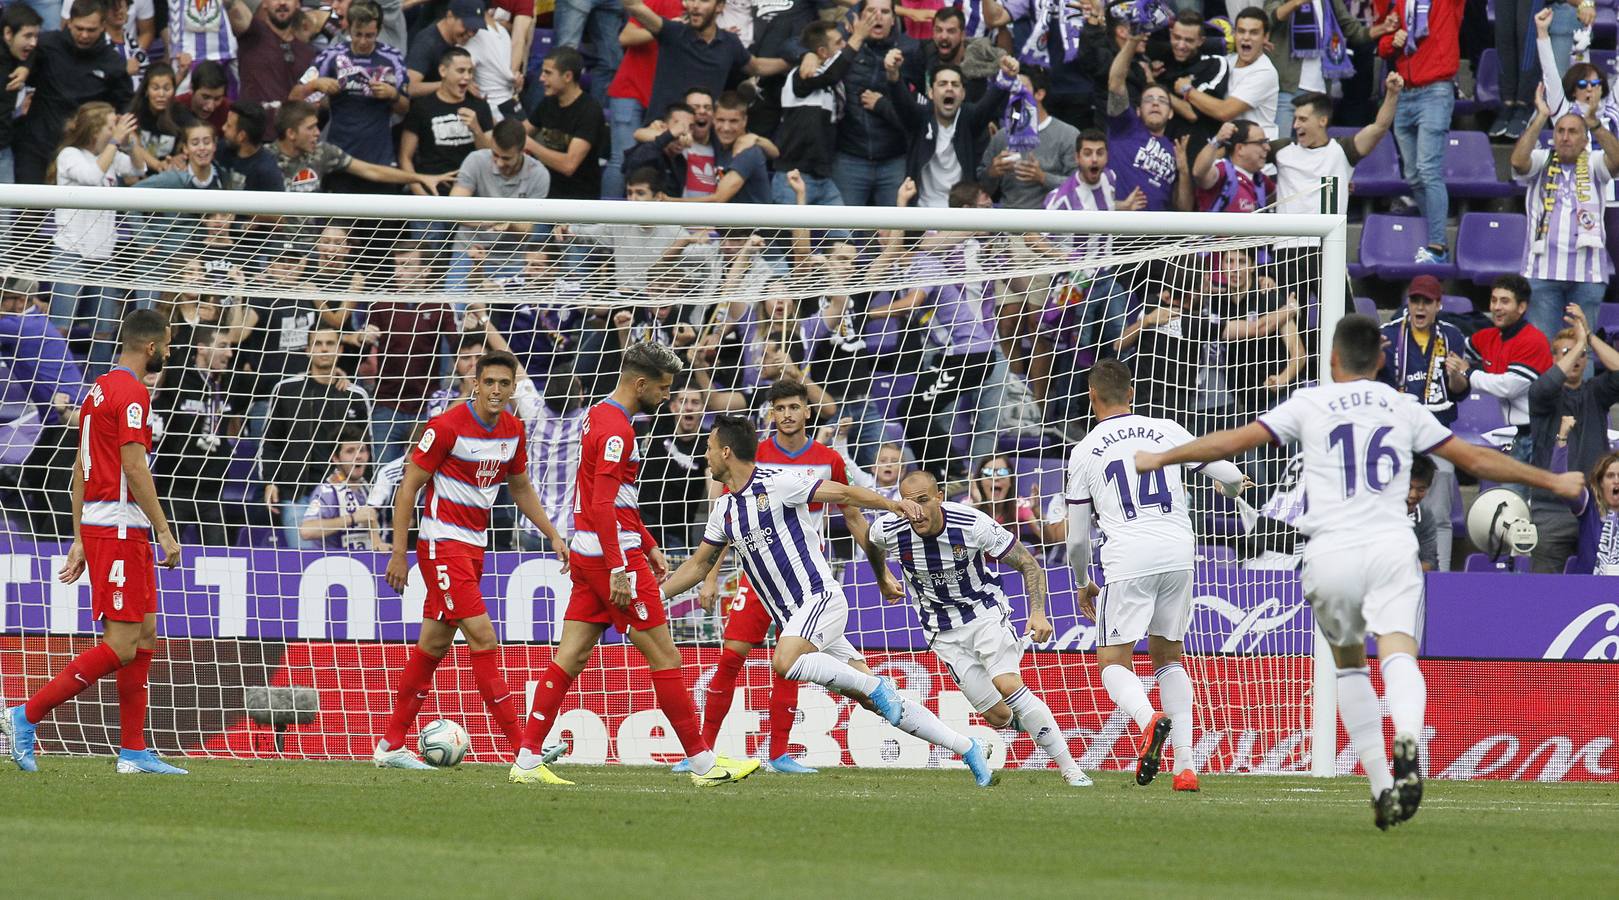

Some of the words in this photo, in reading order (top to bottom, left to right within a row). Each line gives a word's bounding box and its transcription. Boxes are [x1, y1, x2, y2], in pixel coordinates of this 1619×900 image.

[1329, 391, 1373, 412] FEDE
[1092, 427, 1164, 457] R.ALCARAZ
[1327, 423, 1401, 500] 16
[1102, 459, 1173, 522] 14
[108, 560, 126, 587] 4
[436, 564, 450, 590] 5
